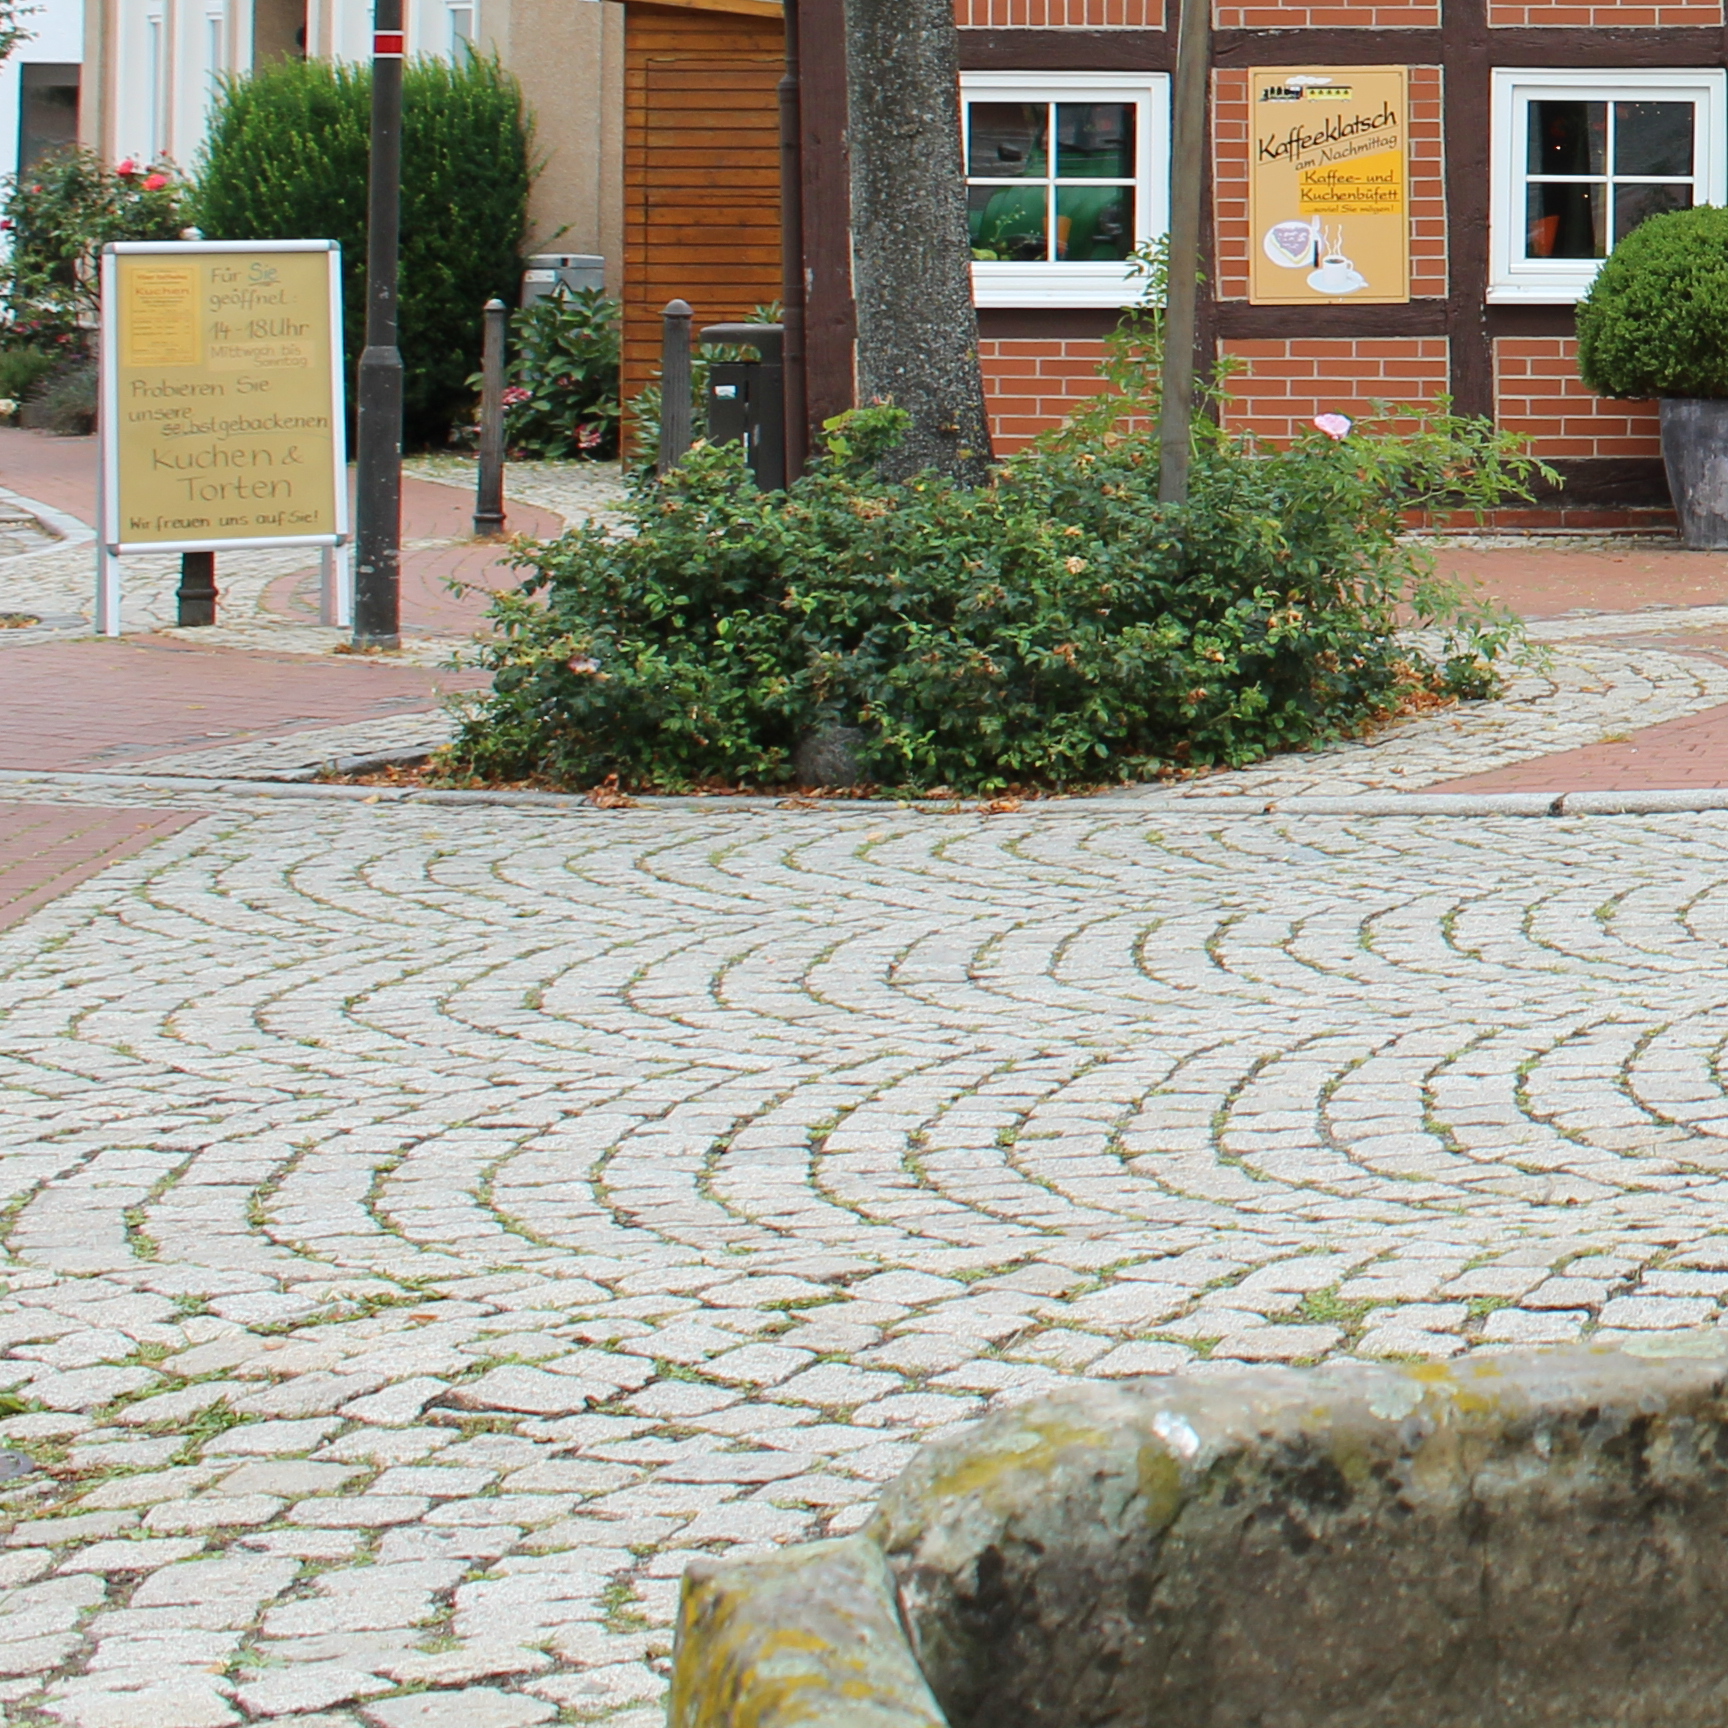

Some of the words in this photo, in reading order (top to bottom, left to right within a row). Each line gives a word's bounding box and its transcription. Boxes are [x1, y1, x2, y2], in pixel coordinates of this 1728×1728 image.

[1258, 100, 1397, 163] Kaffeeklatsch
[1295, 158, 1316, 171] am
[1318, 135, 1398, 167] Nachmittag
[1305, 169, 1362, 187] Kaffee-
[1366, 169, 1394, 183] und
[1301, 186, 1398, 204] Kuchenbüfett
[1341, 204, 1357, 213] Sie
[211, 266, 241, 284] Für
[248, 262, 278, 282] Sie
[131, 379, 225, 398] Probieren
[236, 376, 270, 394] Sie
[128, 406, 193, 423] unsere
[152, 444, 273, 471] Kuchen
[281, 445, 305, 466] &
[176, 475, 293, 502] Torten
[130, 516, 150, 530] Wir
[157, 515, 211, 532] freuen
[219, 515, 249, 526] uns
[255, 510, 286, 526] auf
[287, 509, 319, 524] Sie!
